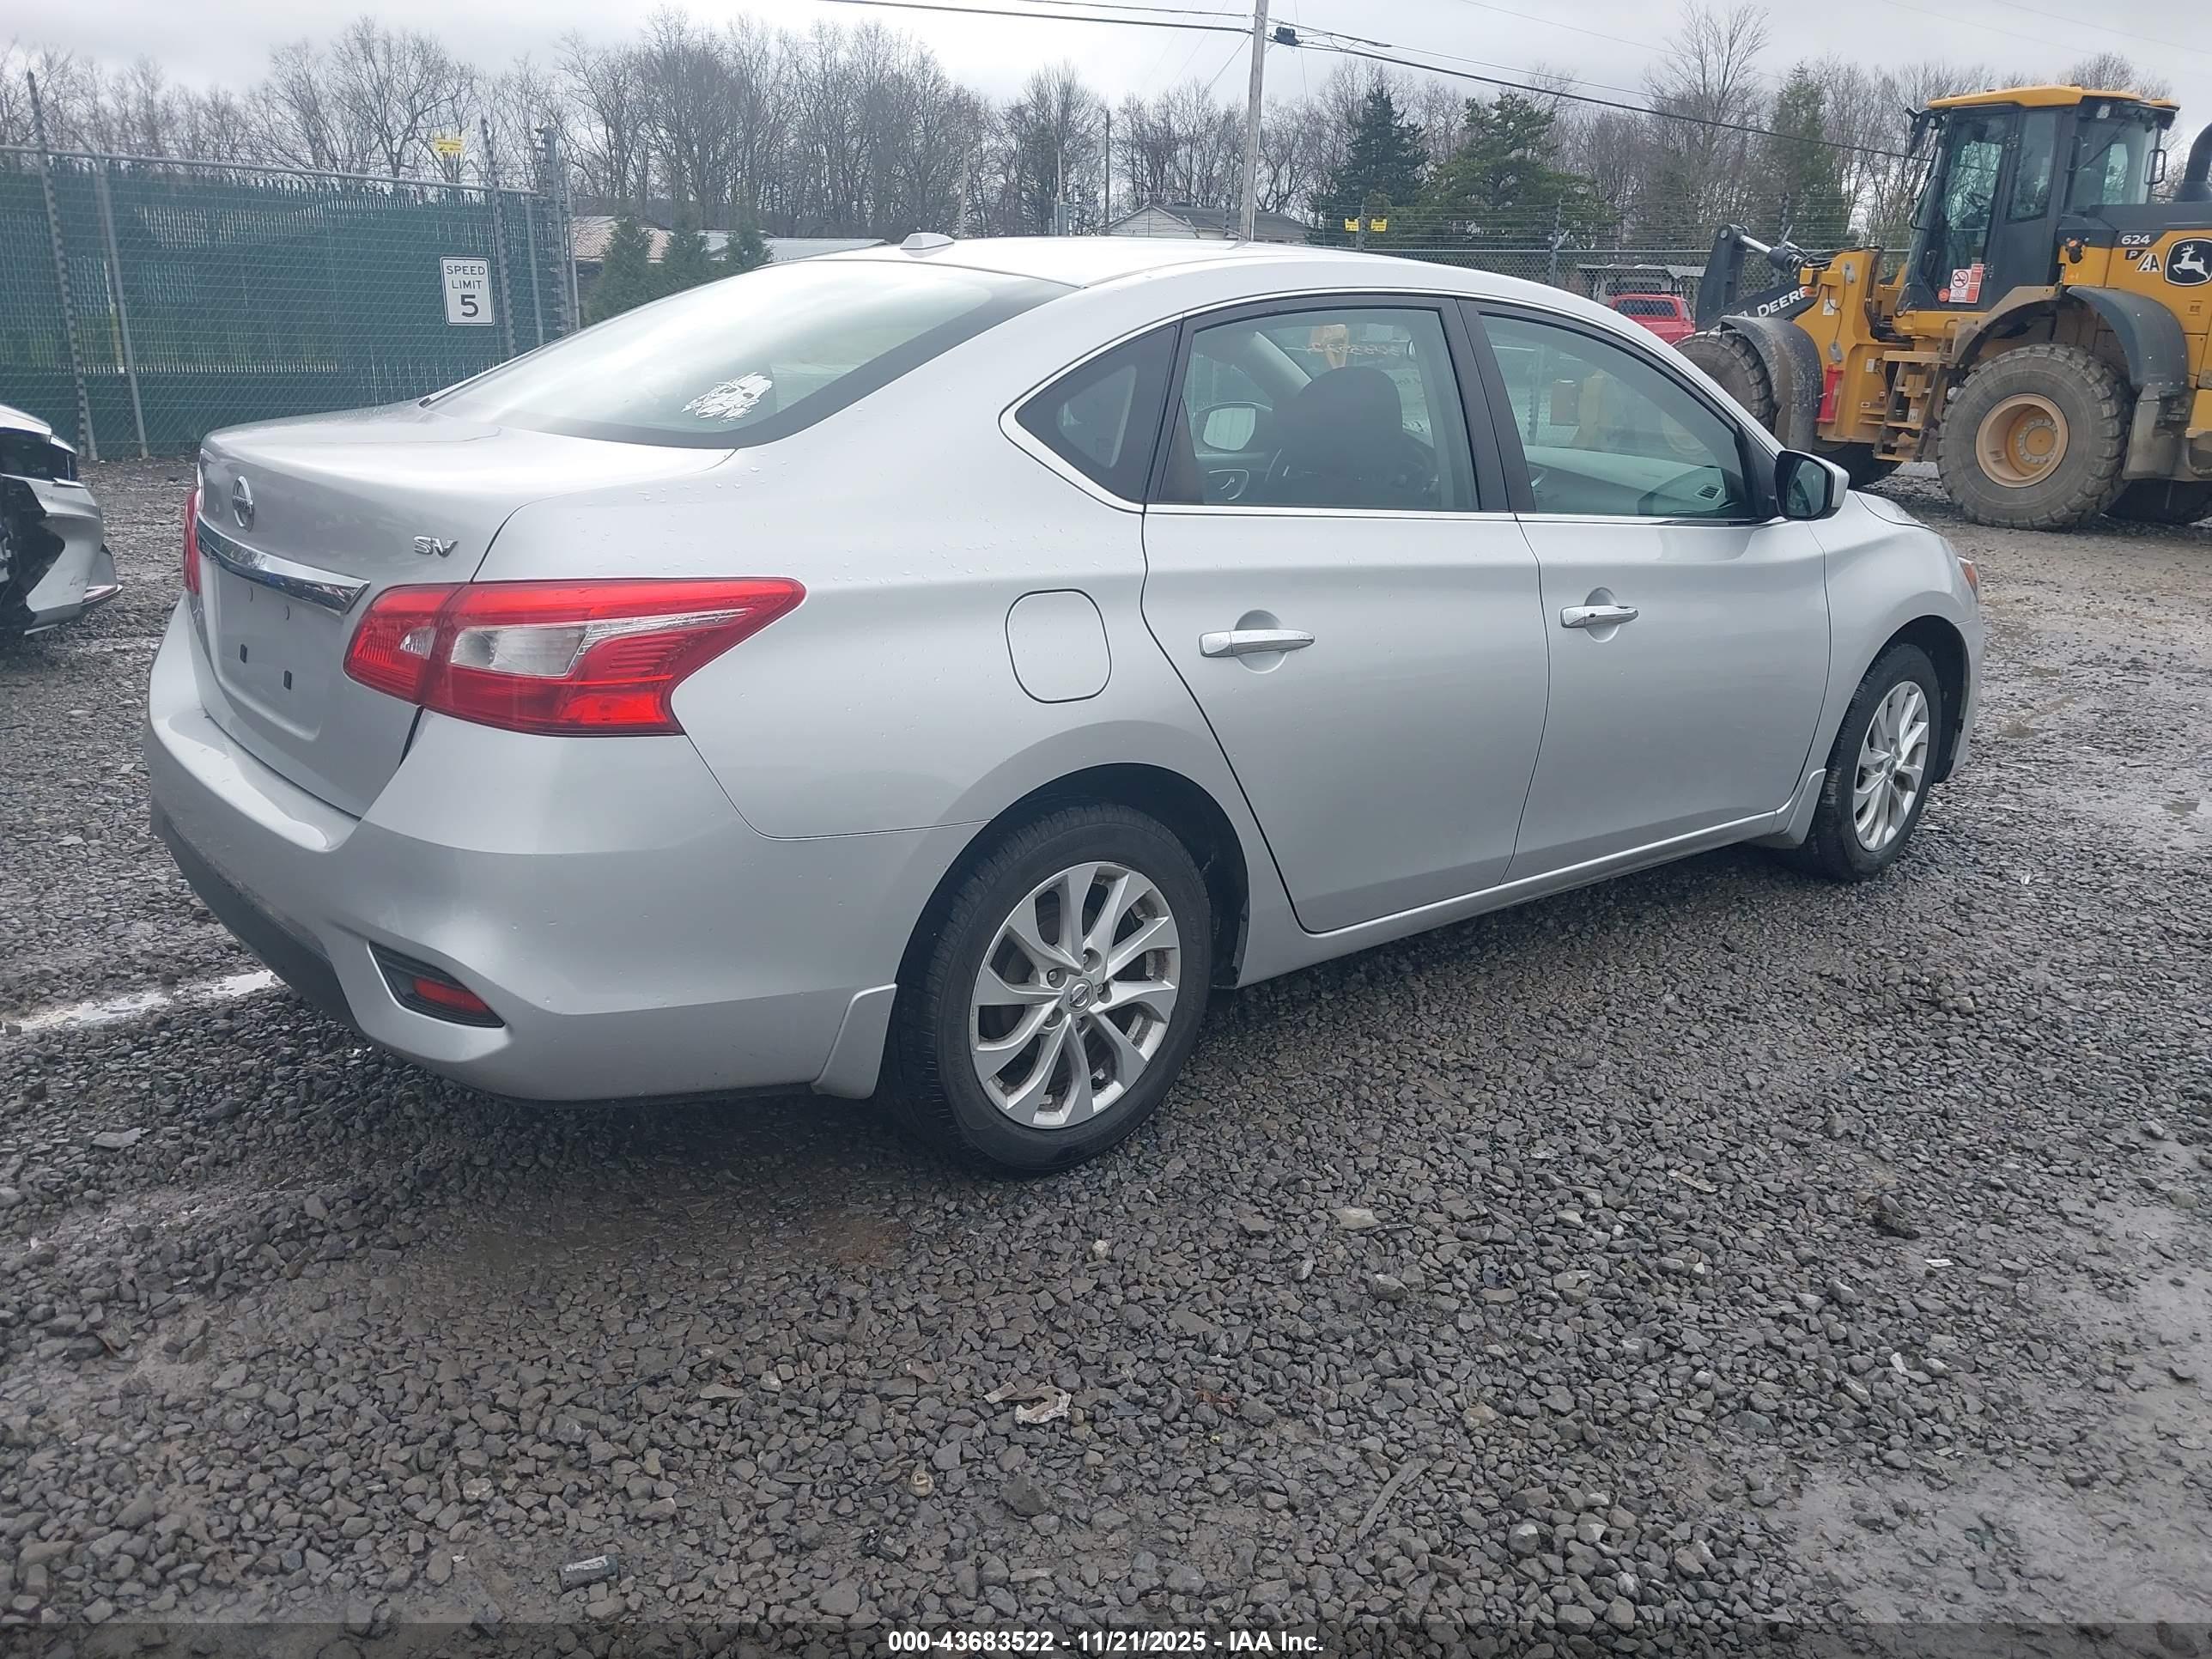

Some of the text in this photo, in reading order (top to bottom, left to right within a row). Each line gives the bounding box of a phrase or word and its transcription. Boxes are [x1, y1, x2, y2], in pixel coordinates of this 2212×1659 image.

[2121, 234, 2151, 245] 624
[2129, 251, 2138, 259] P
[446, 265, 486, 276] SPEED
[452, 279, 483, 289] LIMIT
[460, 294, 479, 318] 5
[413, 535, 459, 557] SV
